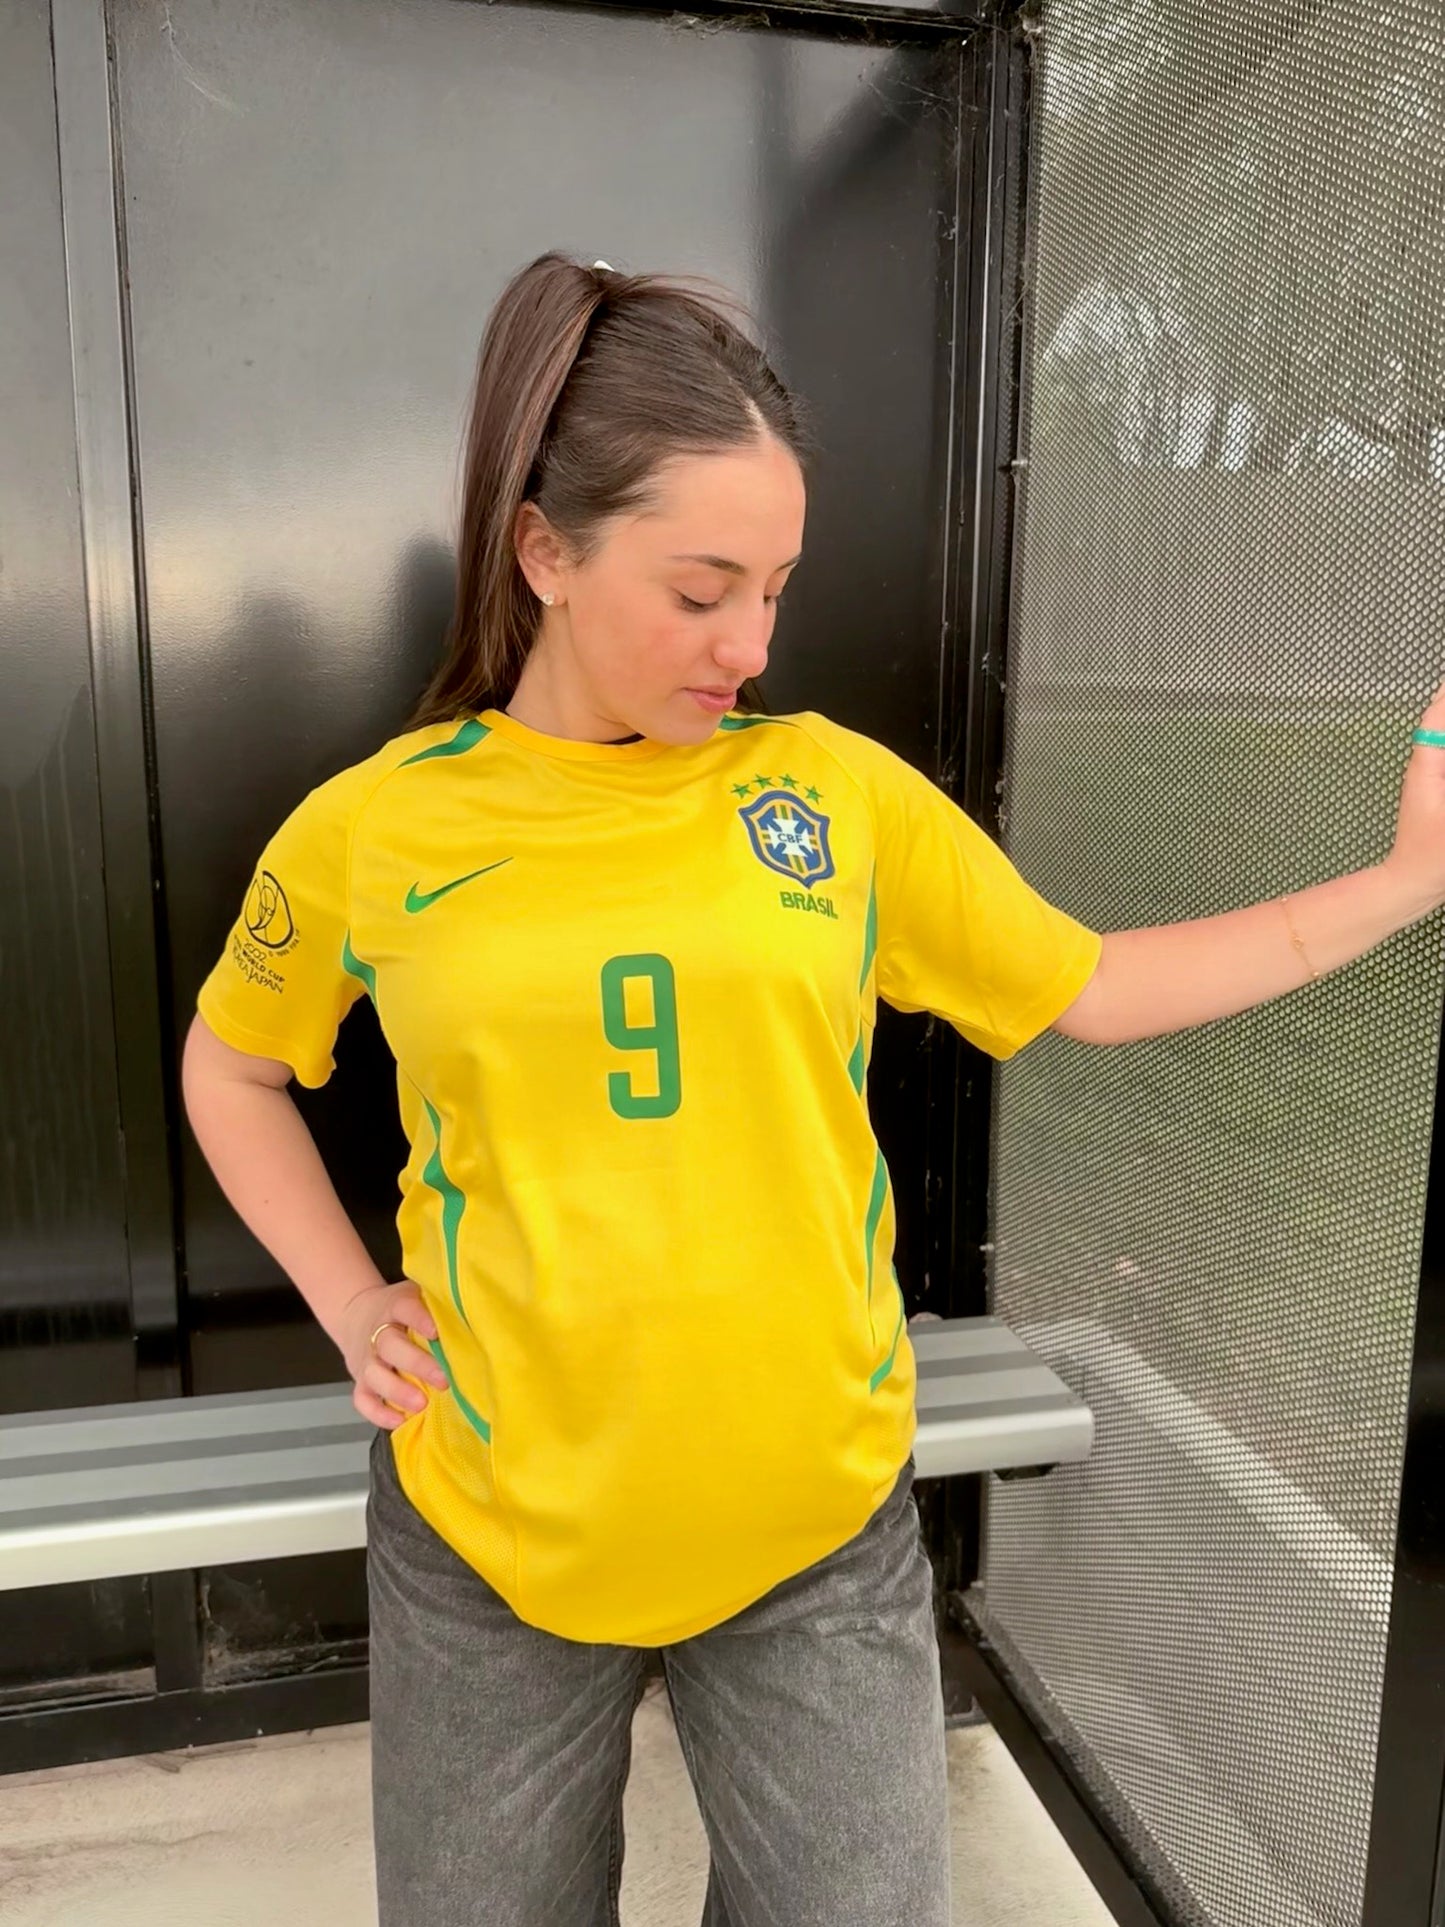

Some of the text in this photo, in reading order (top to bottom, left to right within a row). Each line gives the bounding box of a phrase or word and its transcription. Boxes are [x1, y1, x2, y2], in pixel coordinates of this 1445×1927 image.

[777, 833, 804, 845] CBF
[780, 891, 839, 920] BRASIL
[242, 948, 285, 983] WORLD CUP
[246, 967, 284, 994] JAPAN
[601, 953, 682, 1120] 9
